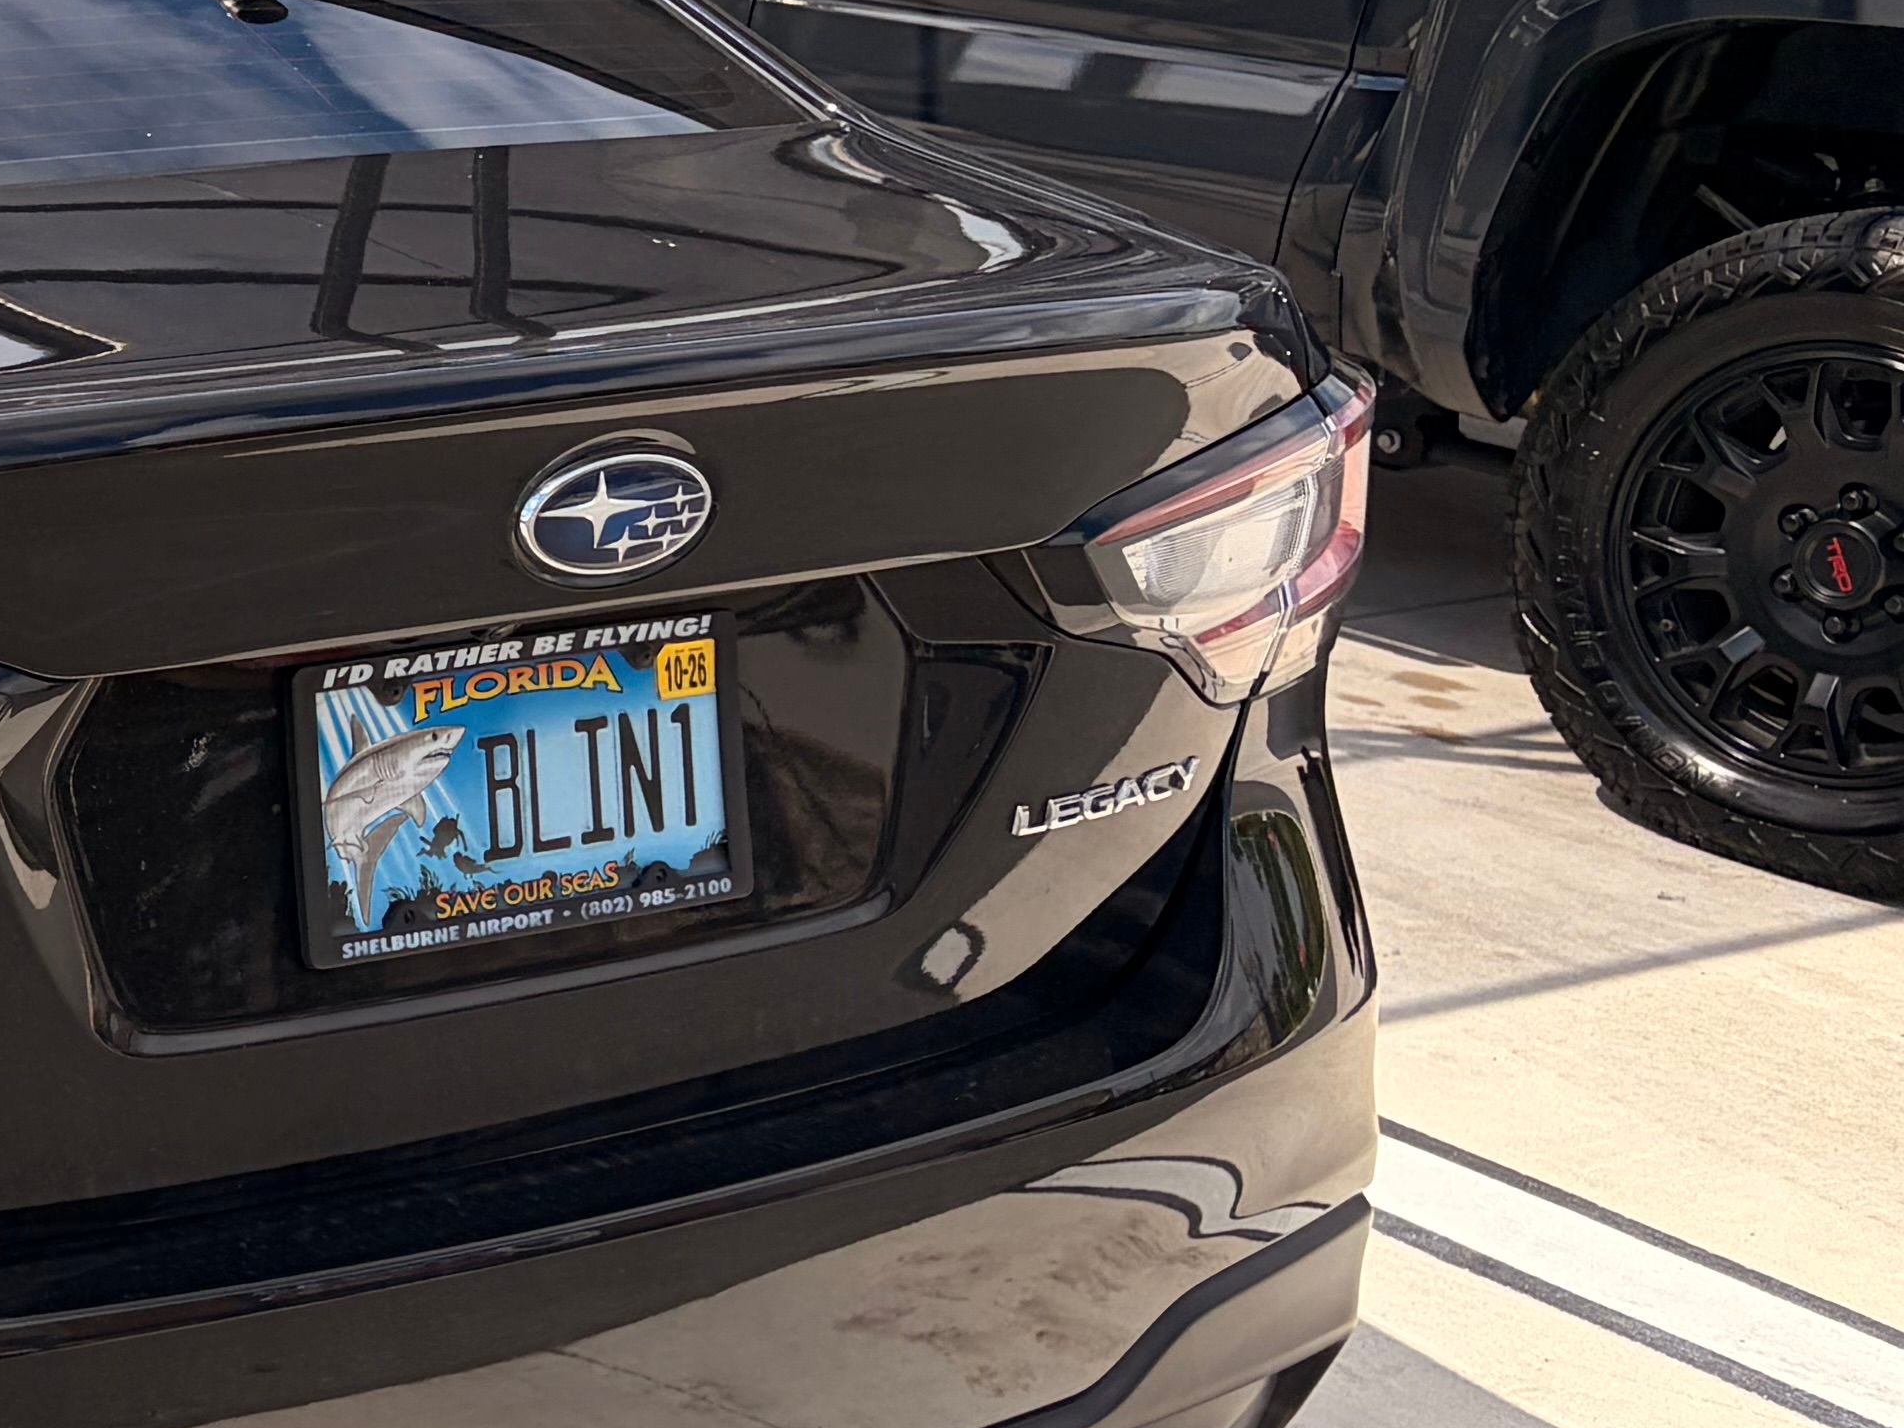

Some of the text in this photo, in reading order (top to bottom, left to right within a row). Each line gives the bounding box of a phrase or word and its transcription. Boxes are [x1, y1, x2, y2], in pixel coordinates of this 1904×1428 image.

[1824, 536, 1854, 595] TRD
[321, 613, 713, 691] I'D RATHER BE FLYING!
[410, 653, 623, 725] FLORIDA
[664, 651, 707, 692] 10-26
[476, 702, 699, 863] BLIN1
[1012, 755, 1201, 837] LEGACY
[341, 877, 733, 960] SHELBURNE AIRPORT (802) 985-2100
[434, 860, 620, 921] SAVE OUR SEAS
